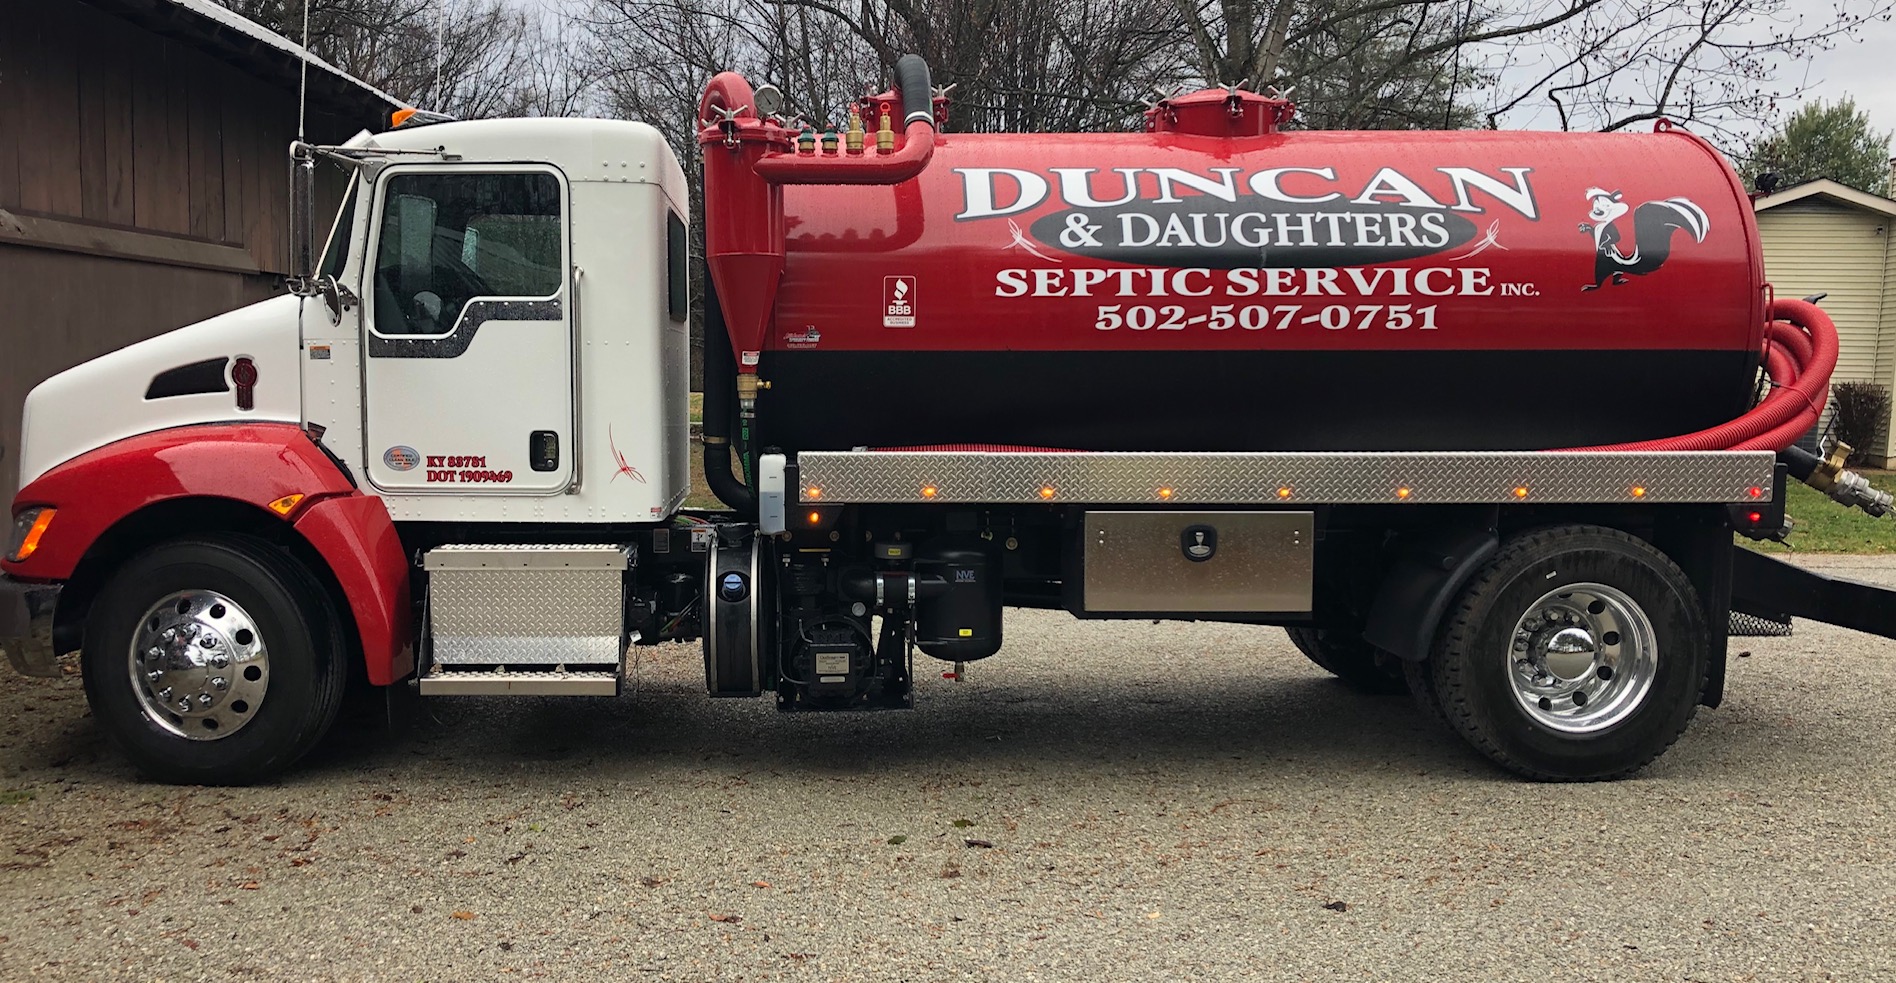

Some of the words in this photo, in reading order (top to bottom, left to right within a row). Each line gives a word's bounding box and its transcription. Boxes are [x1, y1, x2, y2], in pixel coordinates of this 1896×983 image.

[953, 166, 1539, 222] DUNCAN
[1058, 212, 1104, 248] &
[1118, 211, 1450, 248] DAUGHTERS
[994, 267, 1218, 298] SEPTIC
[1226, 267, 1495, 297] SERVICE
[1500, 283, 1540, 297] INC.
[888, 305, 912, 315] BBB
[1095, 304, 1439, 331] 502-507-0751
[427, 456, 446, 468] KY
[448, 456, 487, 468] 83781
[426, 470, 457, 482] DOT
[956, 569, 975, 580] NVE
